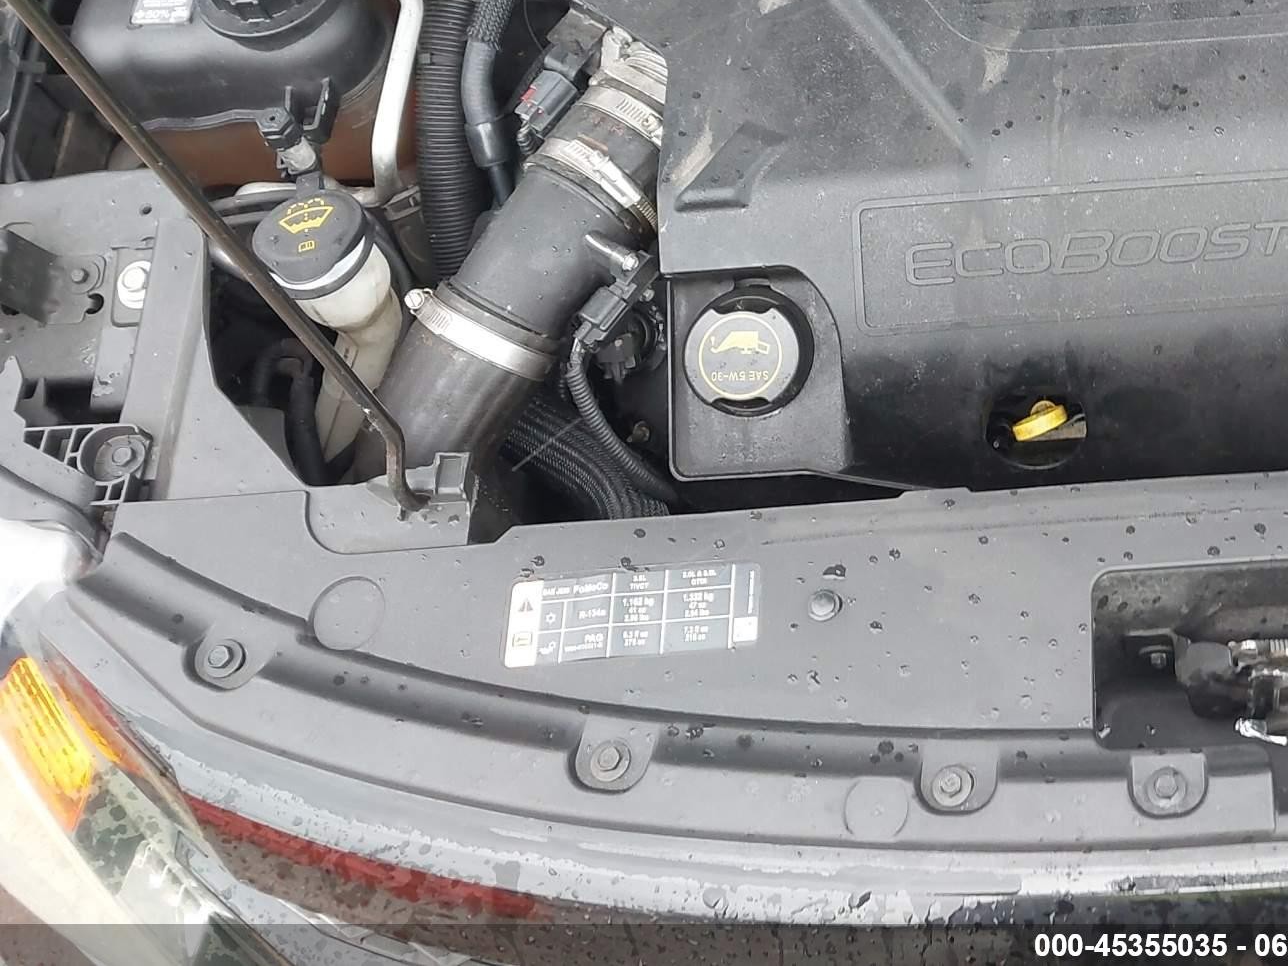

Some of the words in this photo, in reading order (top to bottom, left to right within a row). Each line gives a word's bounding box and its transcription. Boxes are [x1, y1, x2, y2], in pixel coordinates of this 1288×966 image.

[711, 371, 747, 382] 5W-30
[749, 370, 769, 381] SAE
[573, 581, 609, 594] FoMoCo
[579, 608, 607, 619] R-134a
